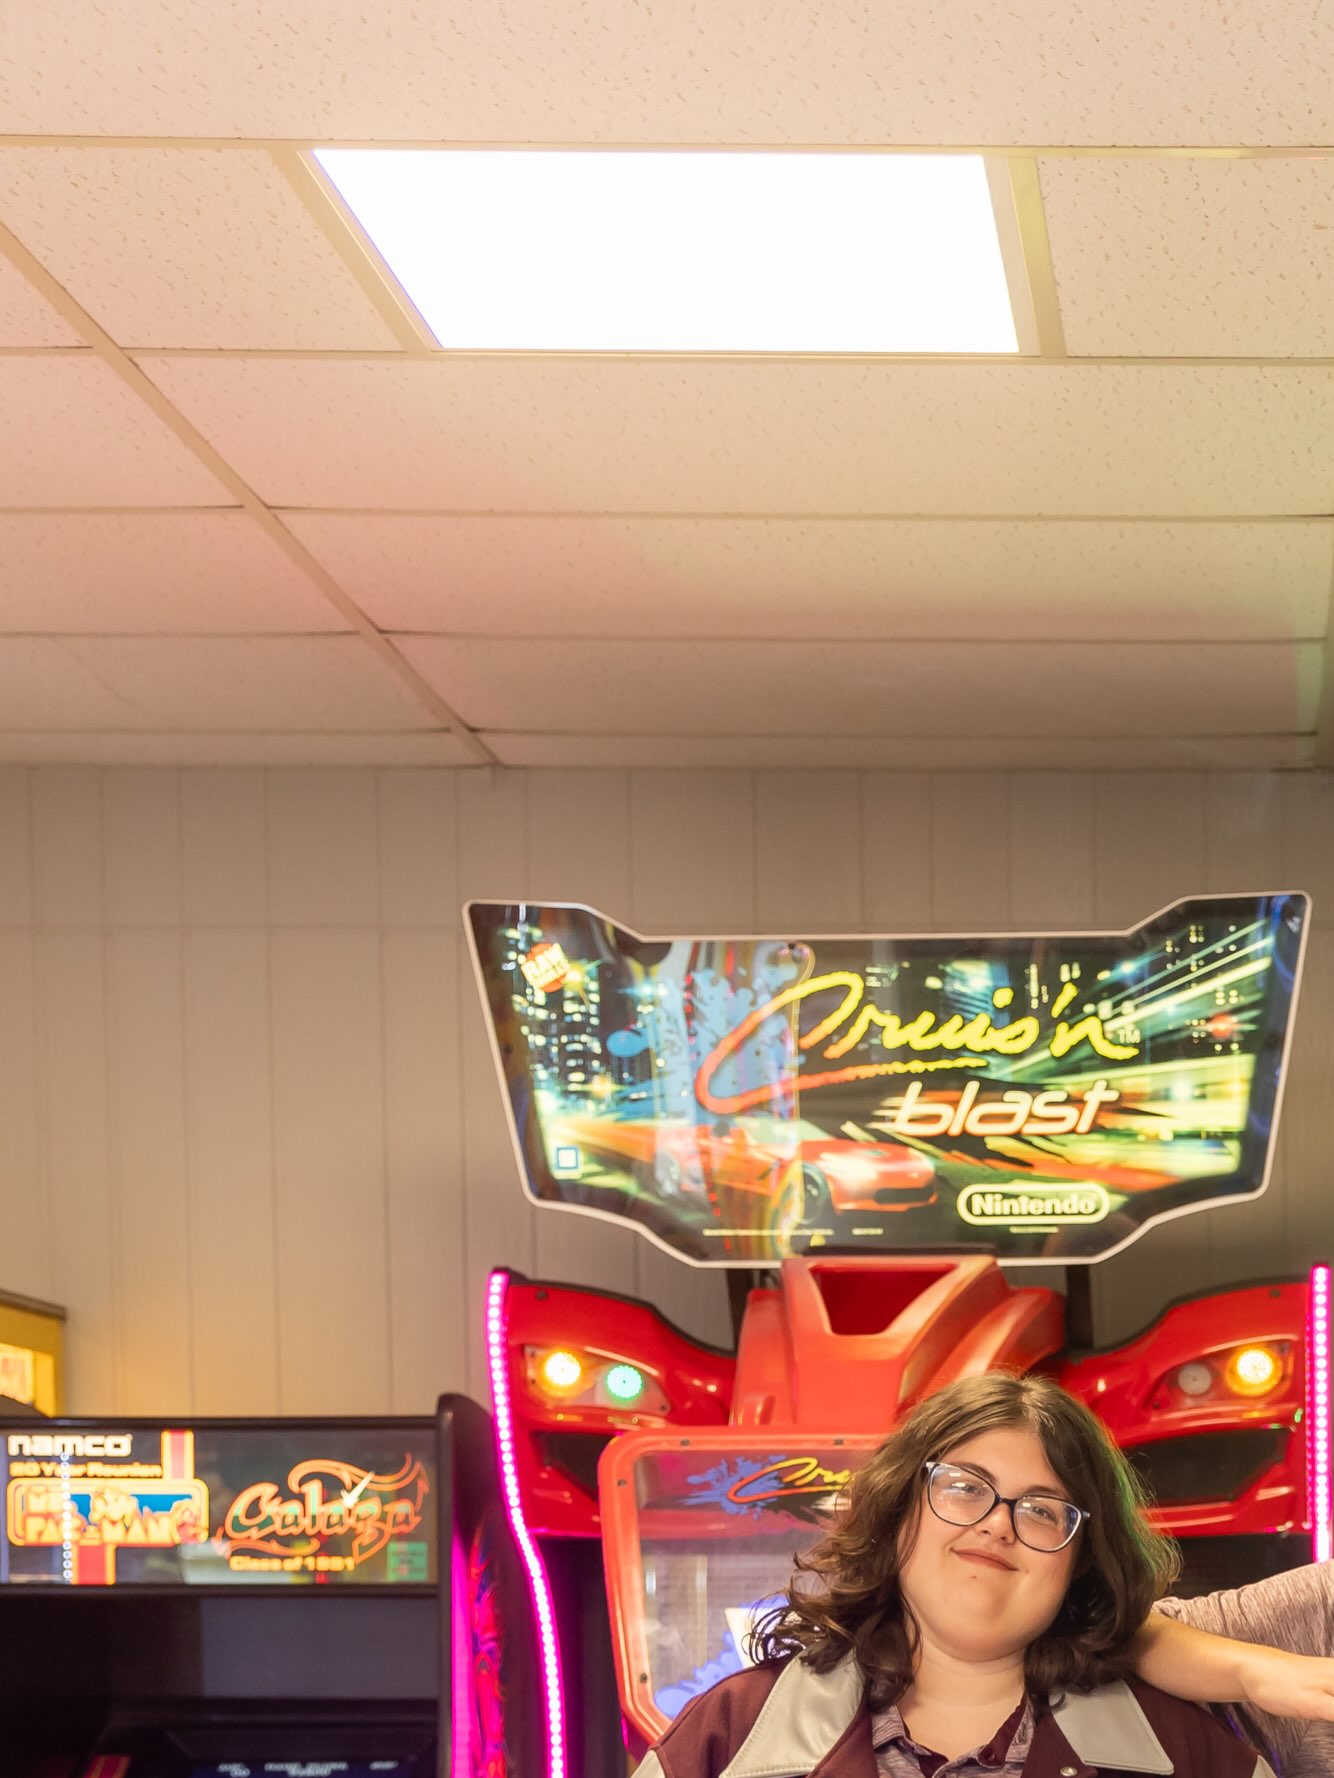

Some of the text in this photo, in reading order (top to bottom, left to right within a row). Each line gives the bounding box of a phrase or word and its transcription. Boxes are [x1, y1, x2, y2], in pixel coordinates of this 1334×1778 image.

[694, 970, 1140, 1115] Cruis'n
[892, 1080, 1121, 1136] blast
[970, 1192, 1097, 1216] Nintendo
[7, 1434, 133, 1457] namco
